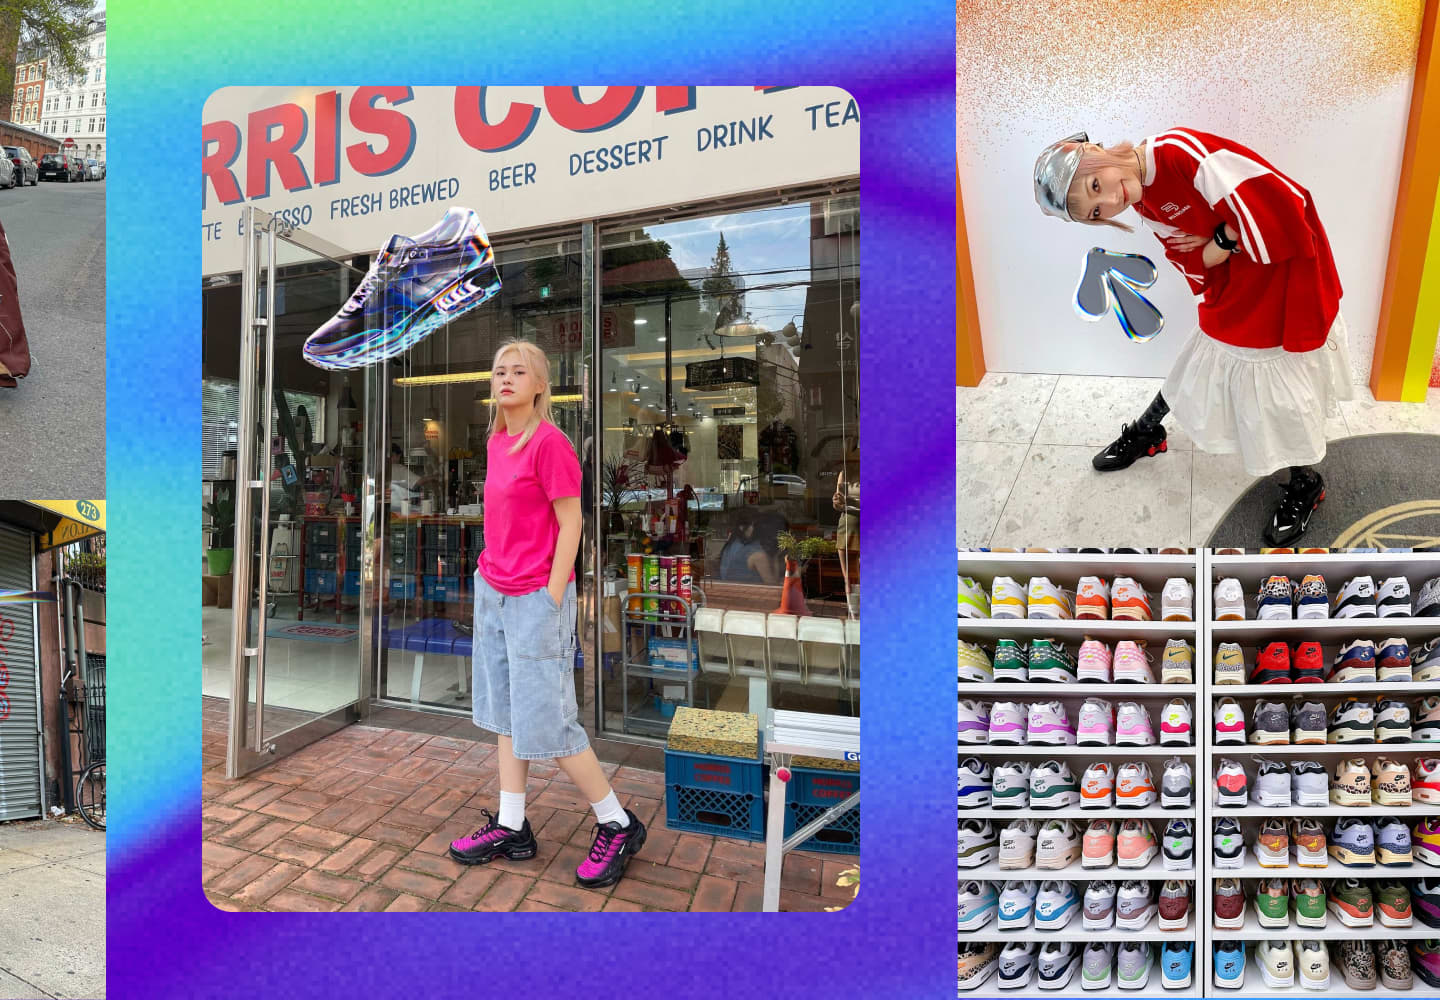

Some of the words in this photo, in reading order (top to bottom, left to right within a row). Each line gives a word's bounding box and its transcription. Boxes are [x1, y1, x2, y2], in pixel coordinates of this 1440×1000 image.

[238, 204, 312, 236] EESSO
[331, 192, 382, 220] FRESH
[389, 177, 460, 209] BREWED
[489, 162, 537, 191] BEER
[569, 136, 669, 176] DESSERT
[697, 114, 774, 152] DRINK
[805, 98, 860, 131] TEA
[80, 502, 97, 519] 273
